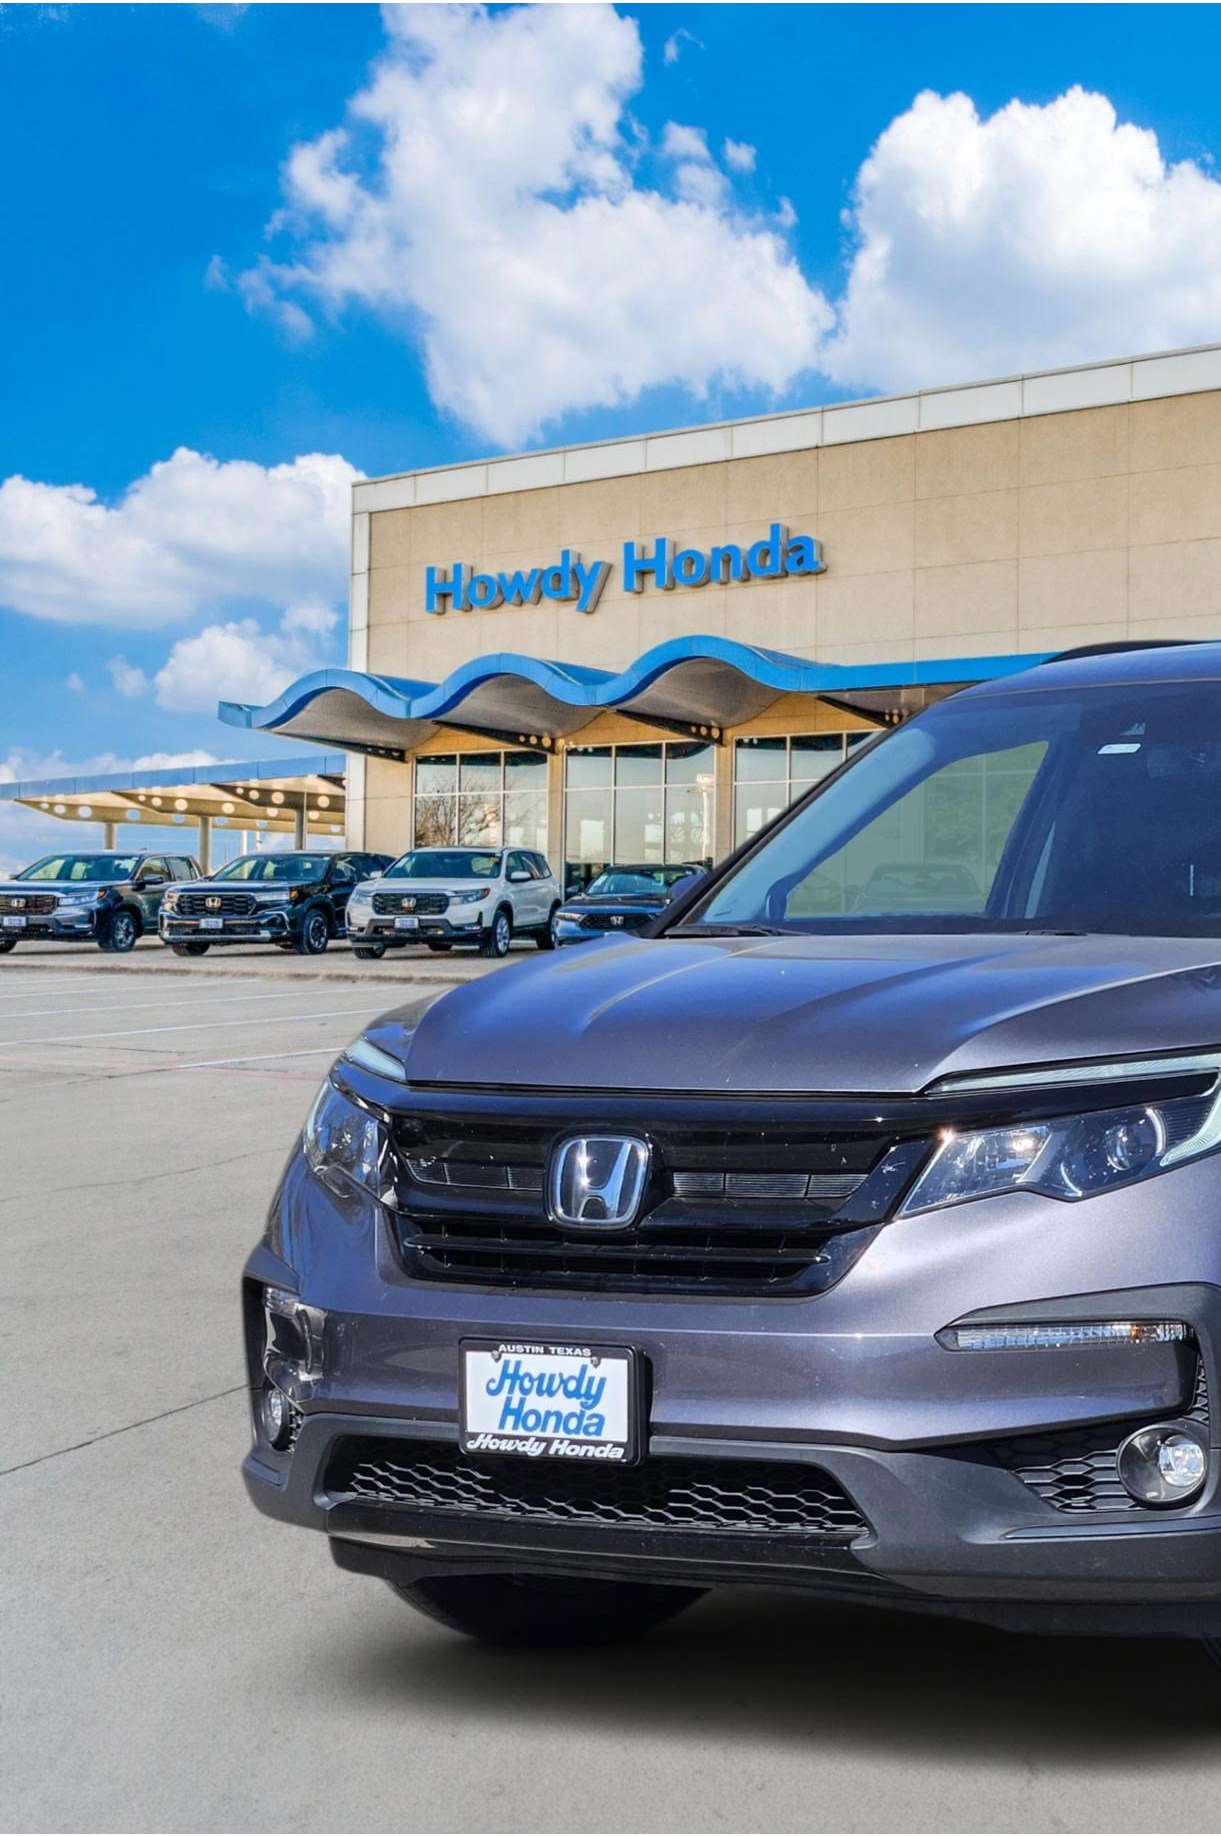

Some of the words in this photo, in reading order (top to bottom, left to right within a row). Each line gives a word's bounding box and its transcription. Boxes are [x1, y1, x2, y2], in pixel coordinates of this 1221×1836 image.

[424, 549, 612, 615] Howdy
[623, 522, 828, 594] Honda
[498, 1344, 544, 1355] AUSTIN
[548, 1346, 592, 1357] TEXAS
[485, 1359, 607, 1410] Howdy
[498, 1396, 606, 1437] Honda
[466, 1433, 547, 1457] Howdy
[549, 1439, 625, 1460] Honda
